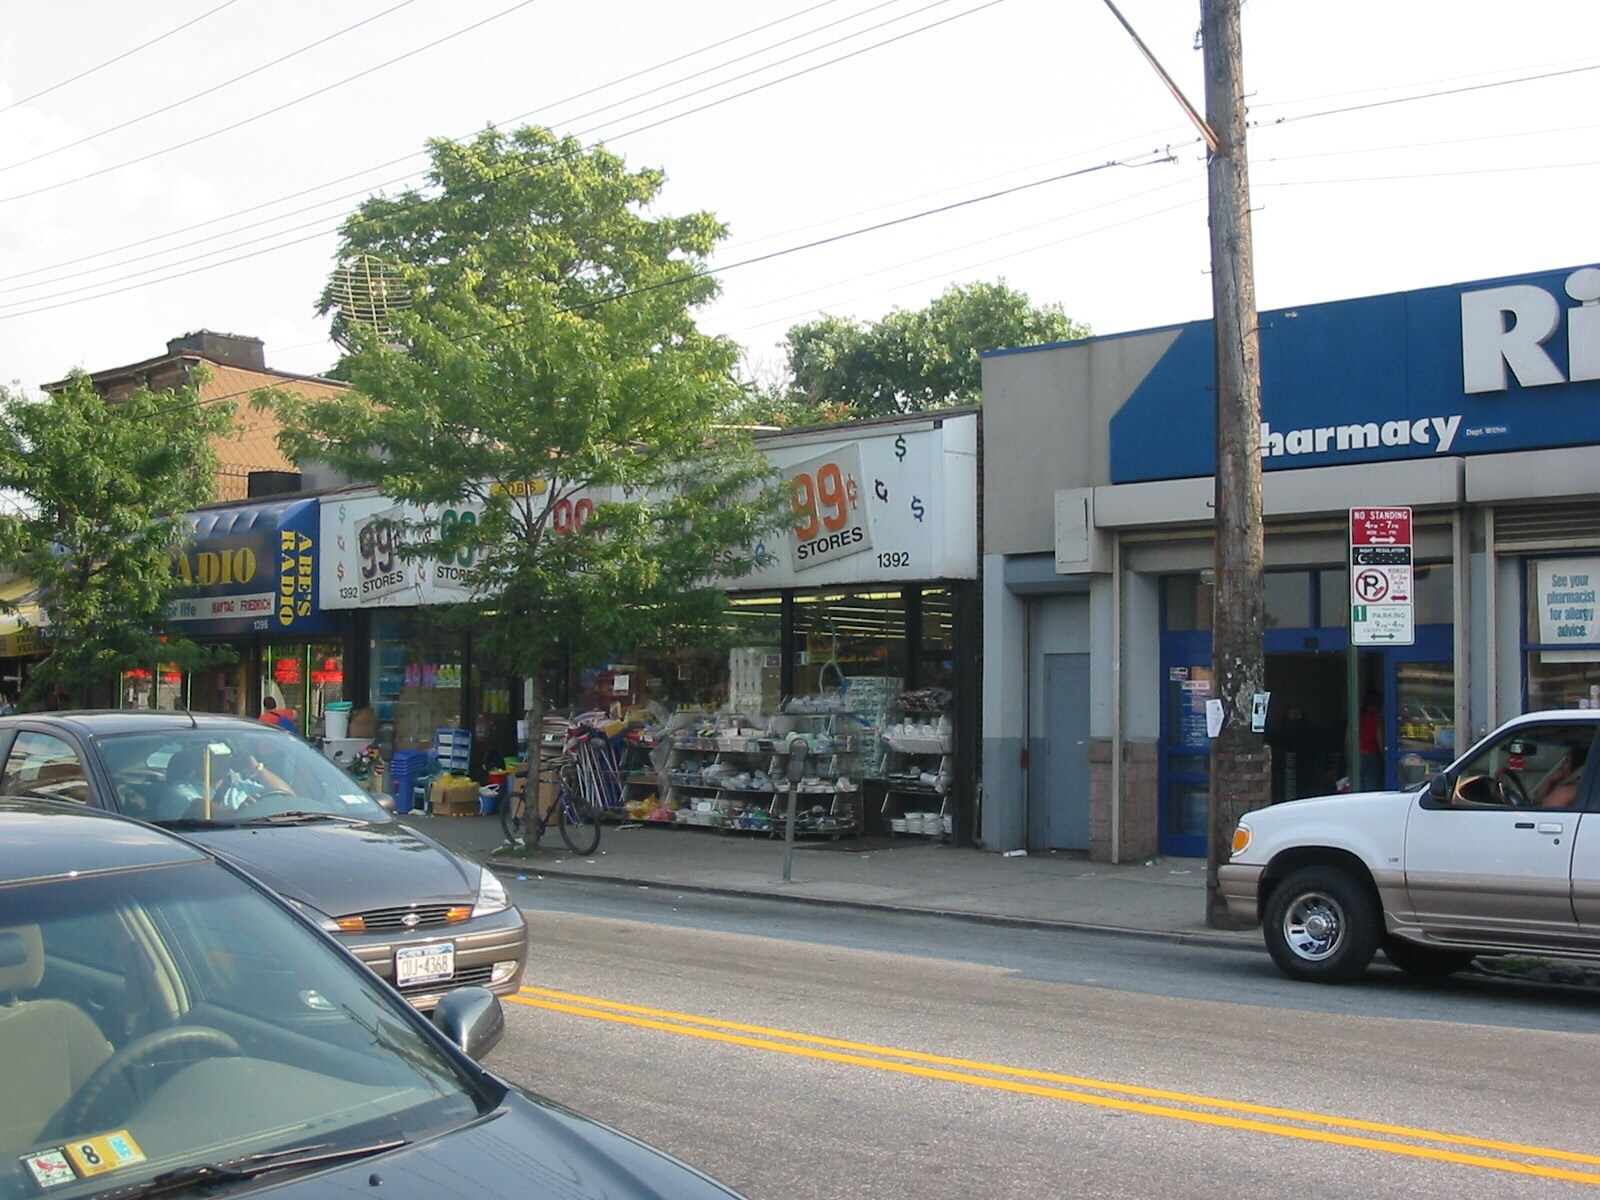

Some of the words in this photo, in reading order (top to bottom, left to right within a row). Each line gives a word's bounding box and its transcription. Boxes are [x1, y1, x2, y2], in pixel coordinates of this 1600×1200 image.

[1261, 415, 1462, 457] harmacy
[1354, 511, 1366, 520] NO
[1370, 510, 1408, 520] STANDING
[797, 526, 863, 560] STORES
[176, 547, 257, 587] ADIO
[877, 552, 909, 568] 1392
[279, 530, 296, 626] RADIO
[297, 532, 313, 617] ABE'S
[362, 570, 404, 594] STORES
[1551, 574, 1567, 587] See
[1569, 574, 1589, 588] your
[340, 587, 359, 599] 1392
[1547, 590, 1595, 606] pharmacist
[1550, 607, 1562, 621] for
[1565, 607, 1594, 622] allergy
